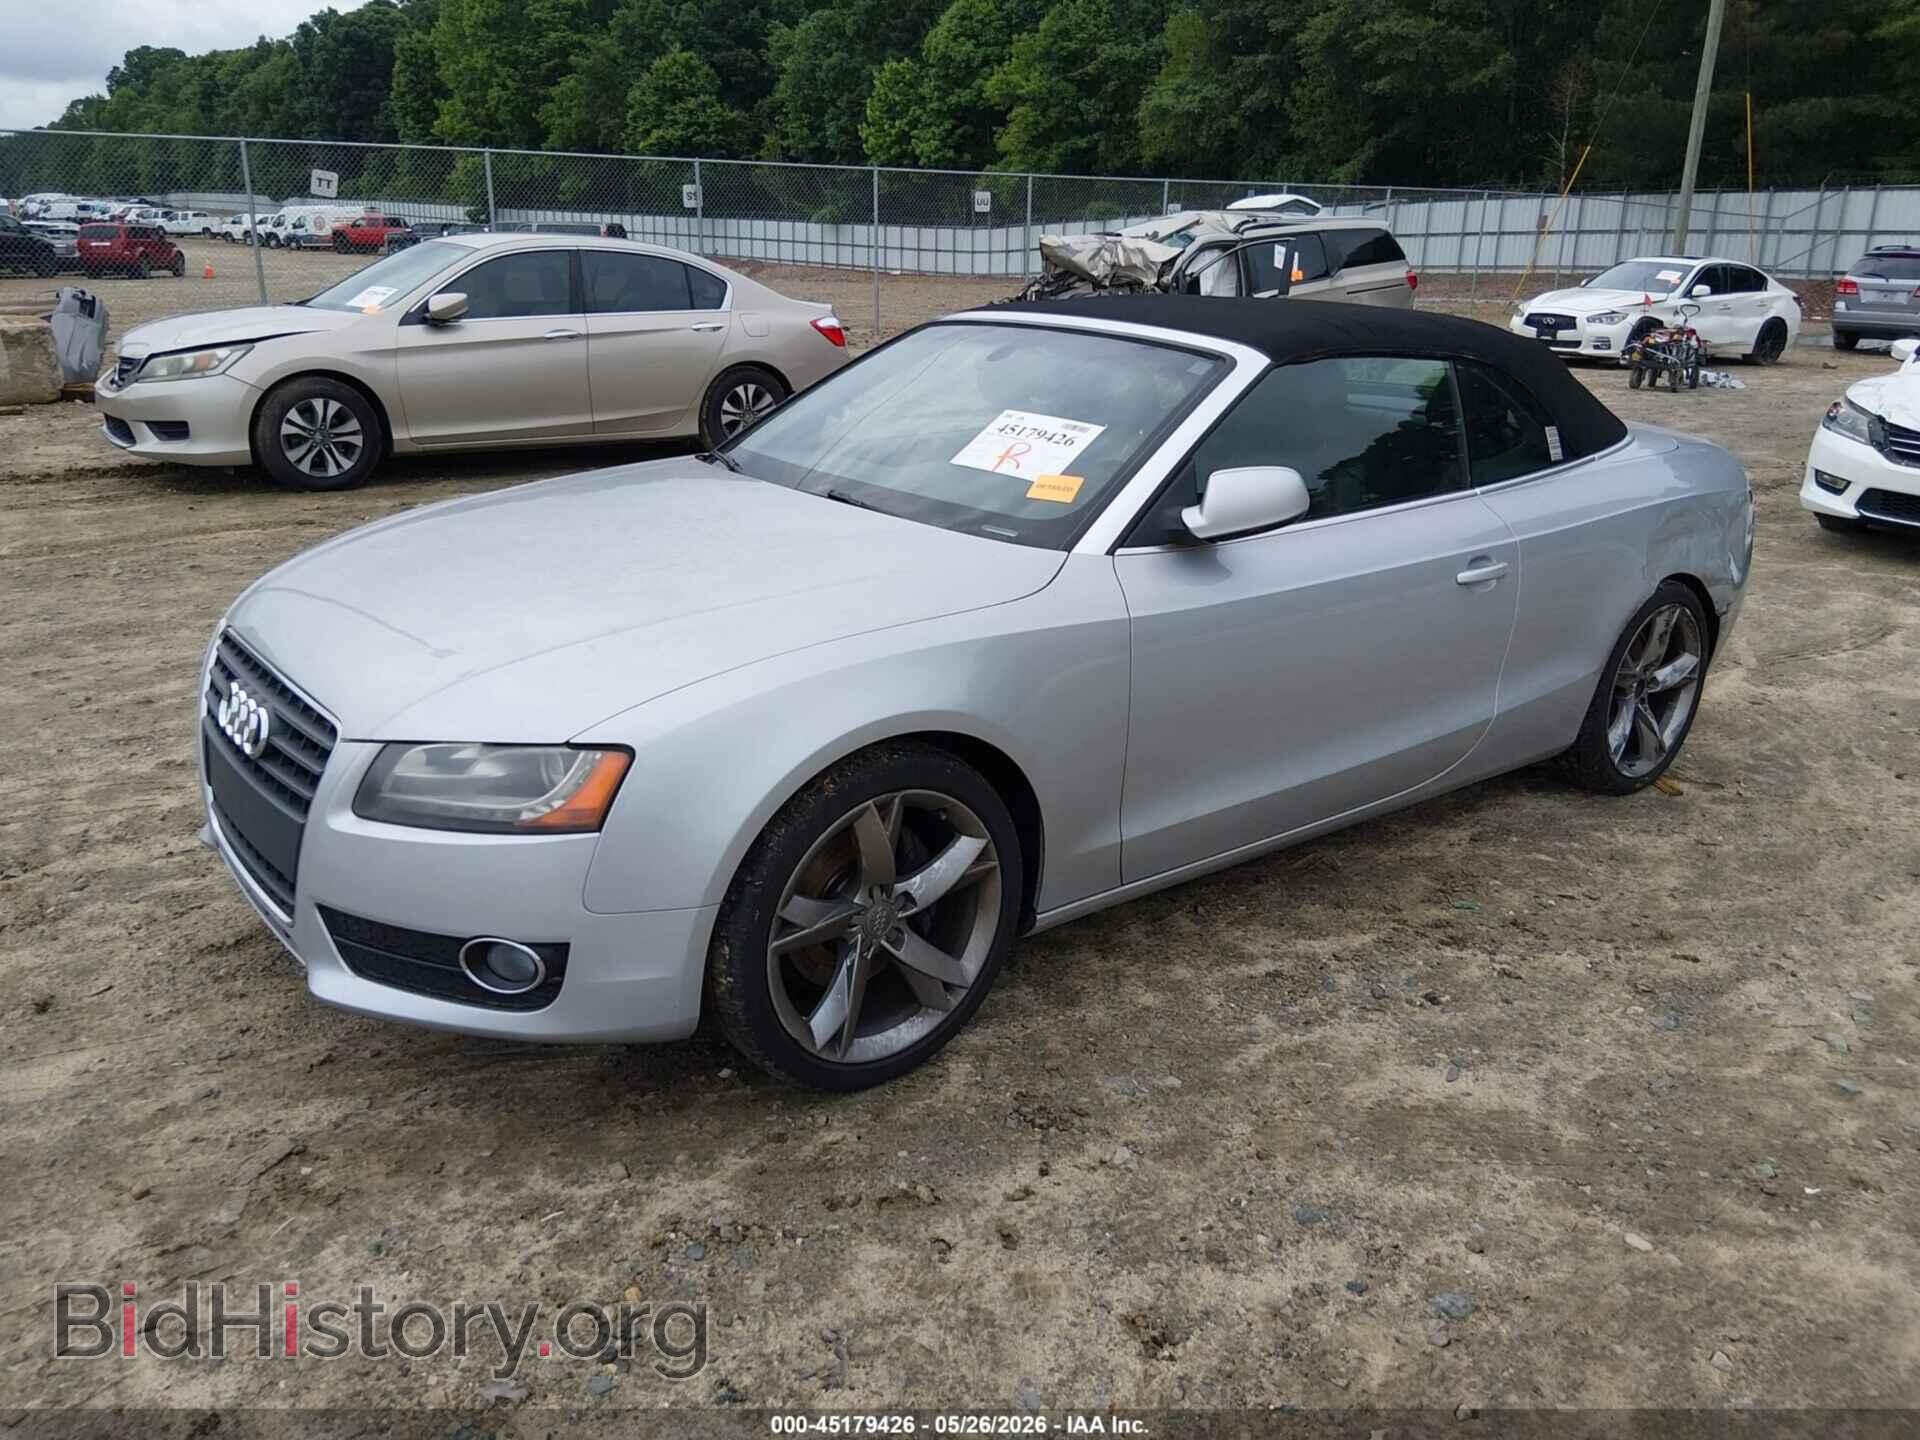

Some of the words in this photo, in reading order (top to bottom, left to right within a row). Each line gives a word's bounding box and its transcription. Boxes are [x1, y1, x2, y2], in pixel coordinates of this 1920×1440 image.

[316, 177, 333, 189] TT
[997, 423, 1076, 447] 45179426
[991, 441, 1032, 472] R
